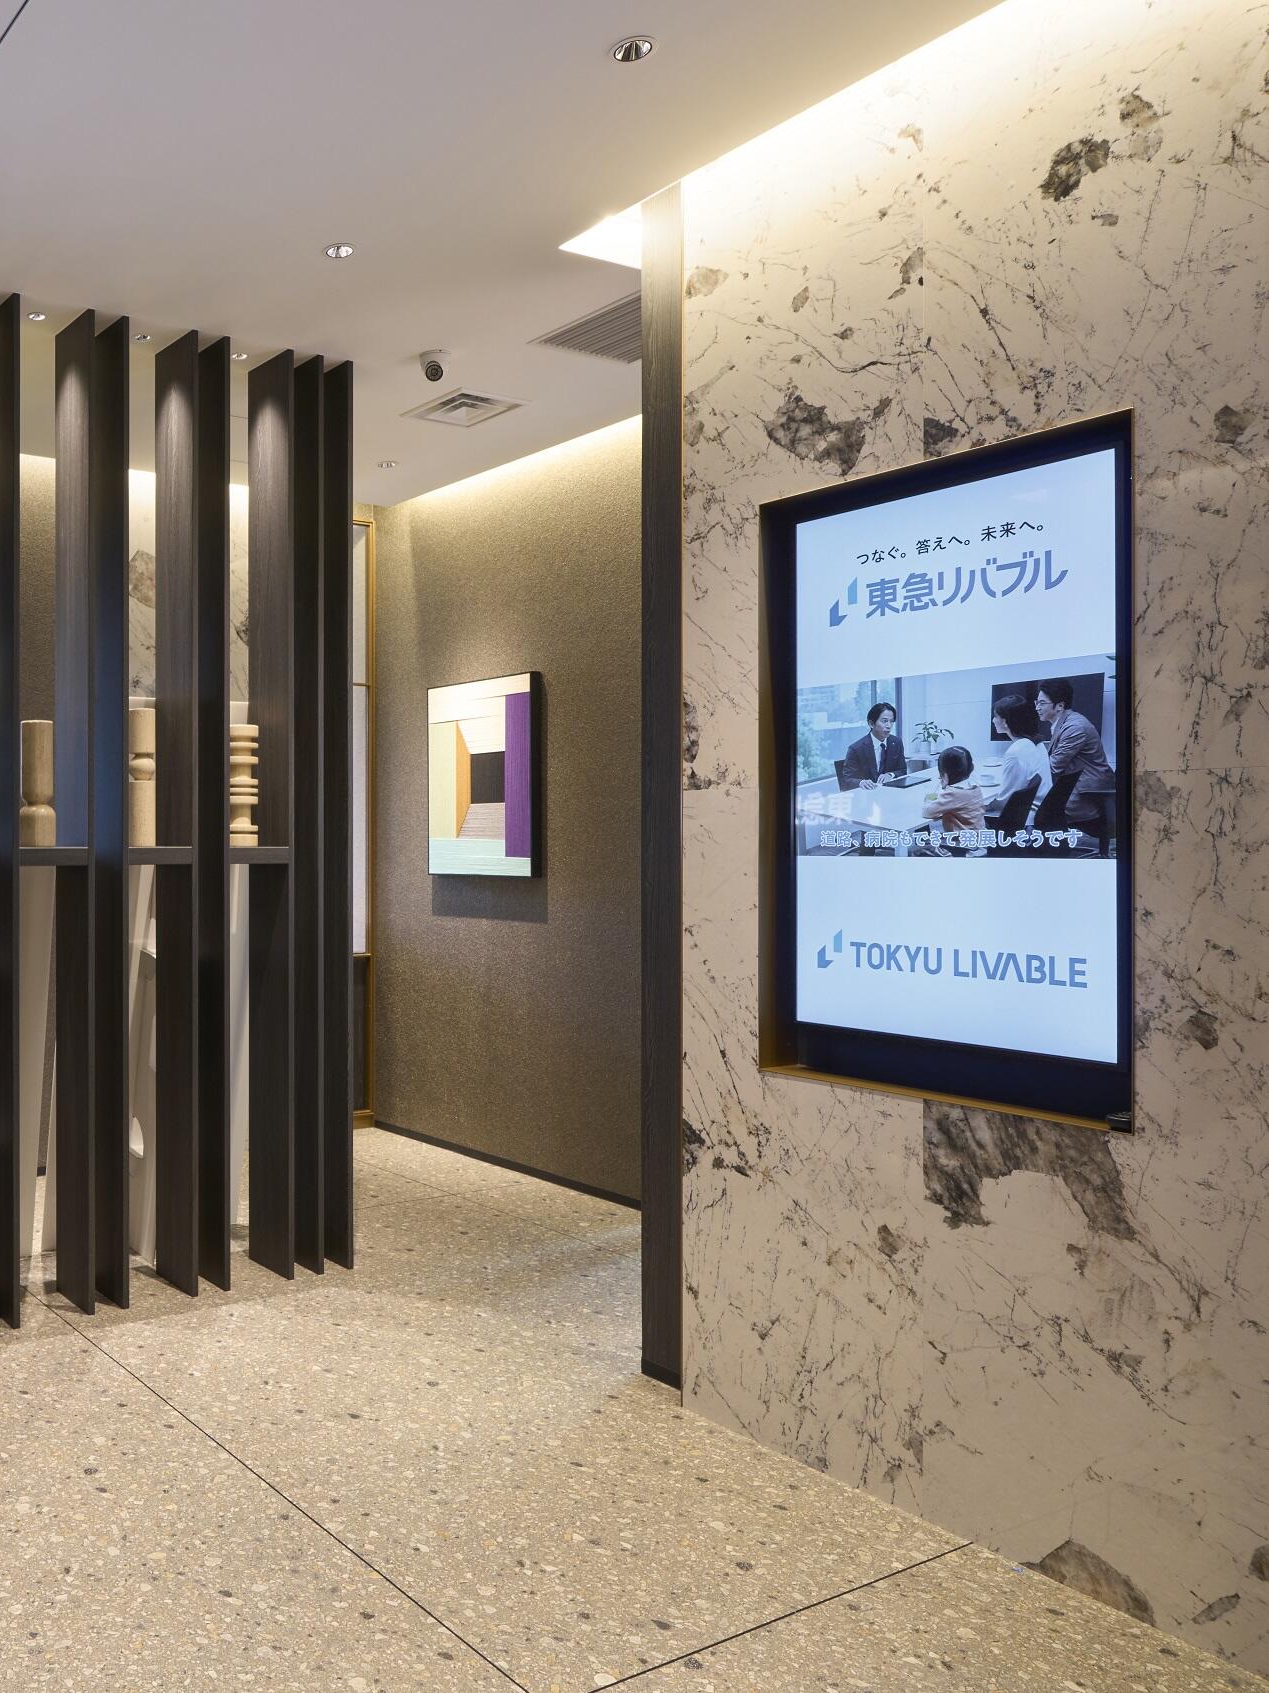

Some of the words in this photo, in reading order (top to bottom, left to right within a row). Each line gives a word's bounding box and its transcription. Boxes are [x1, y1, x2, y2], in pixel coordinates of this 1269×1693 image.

[866, 549, 1069, 619] 東急リバブル
[849, 941, 943, 975] TOKYU
[953, 948, 1088, 989] LIVABLE
